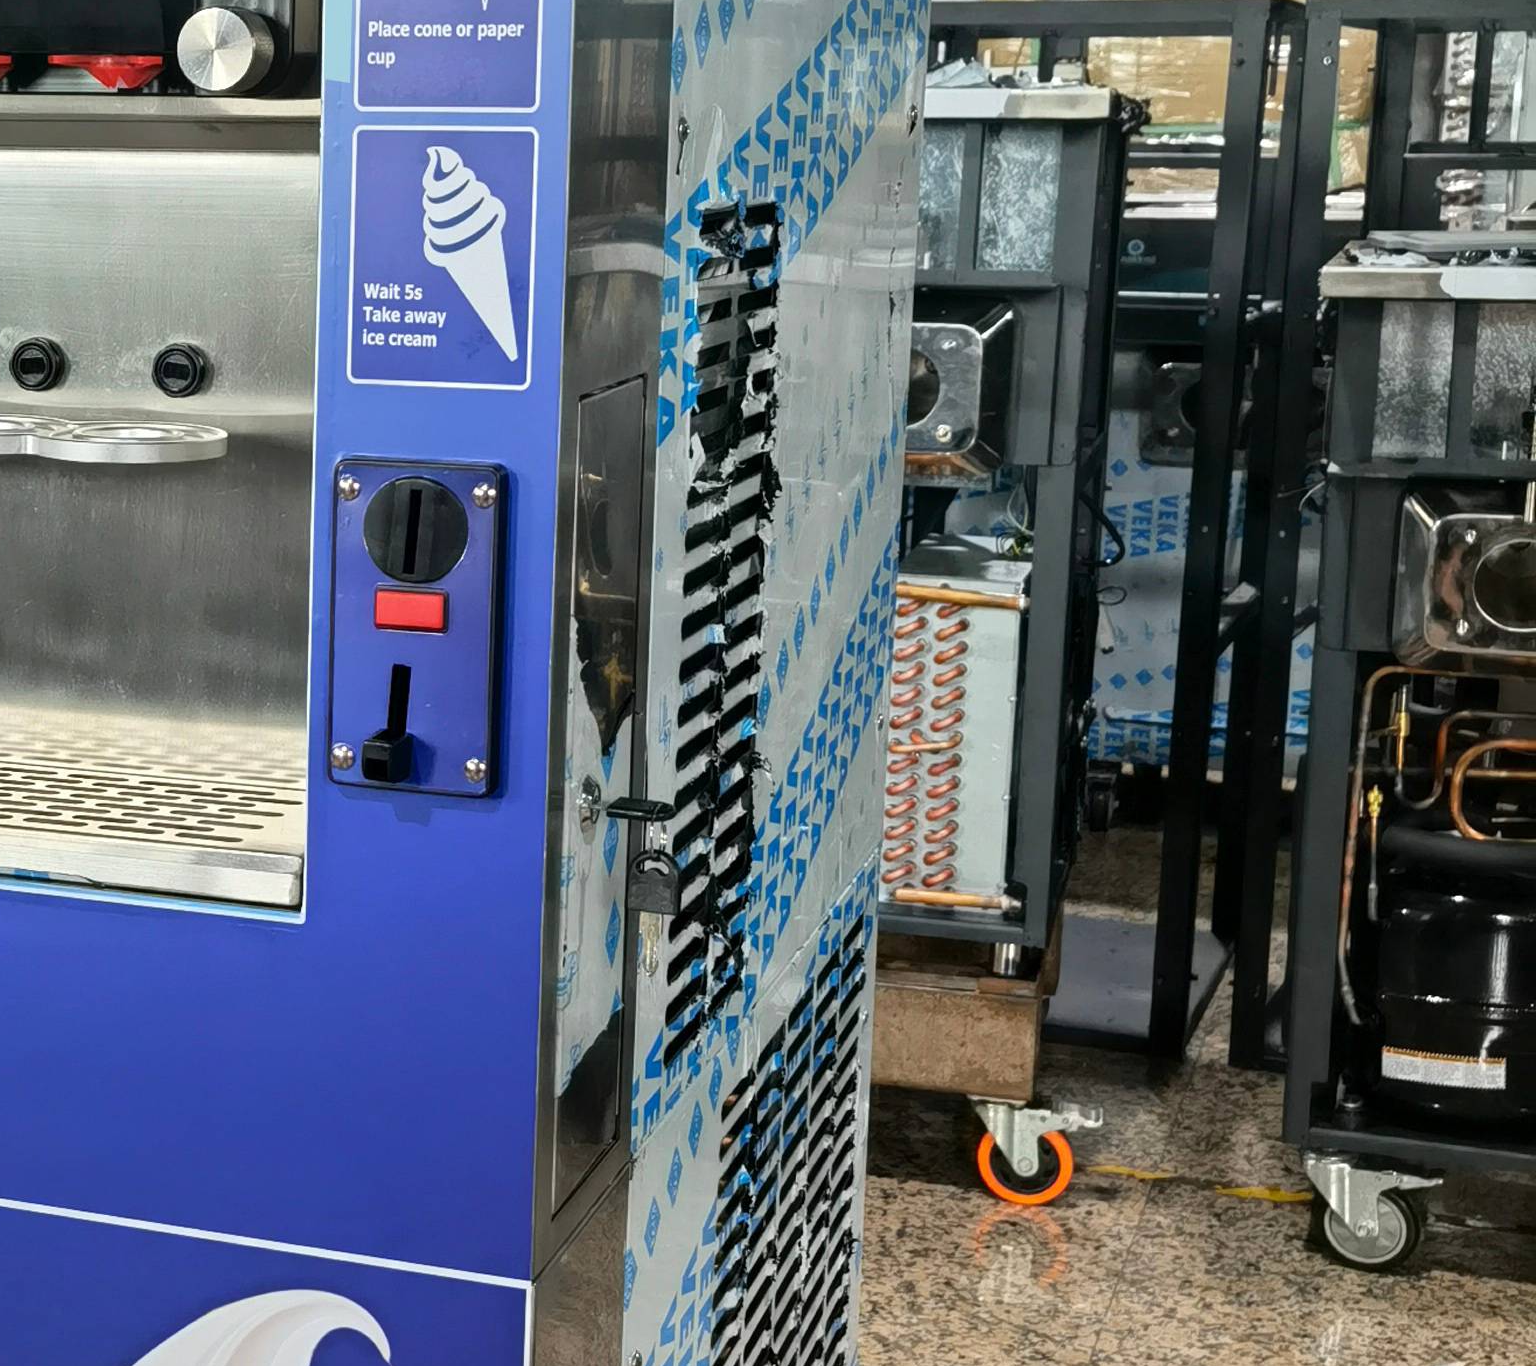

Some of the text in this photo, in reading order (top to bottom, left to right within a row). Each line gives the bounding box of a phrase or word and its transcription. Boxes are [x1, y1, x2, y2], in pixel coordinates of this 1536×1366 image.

[368, 20, 524, 41] Place cone or paper
[367, 51, 395, 69] cup
[805, 35, 828, 239] VEKA
[787, 57, 811, 265] VEKA
[364, 283, 423, 300] Wait 5s
[363, 306, 446, 328] Take away
[362, 329, 437, 347] ice cream
